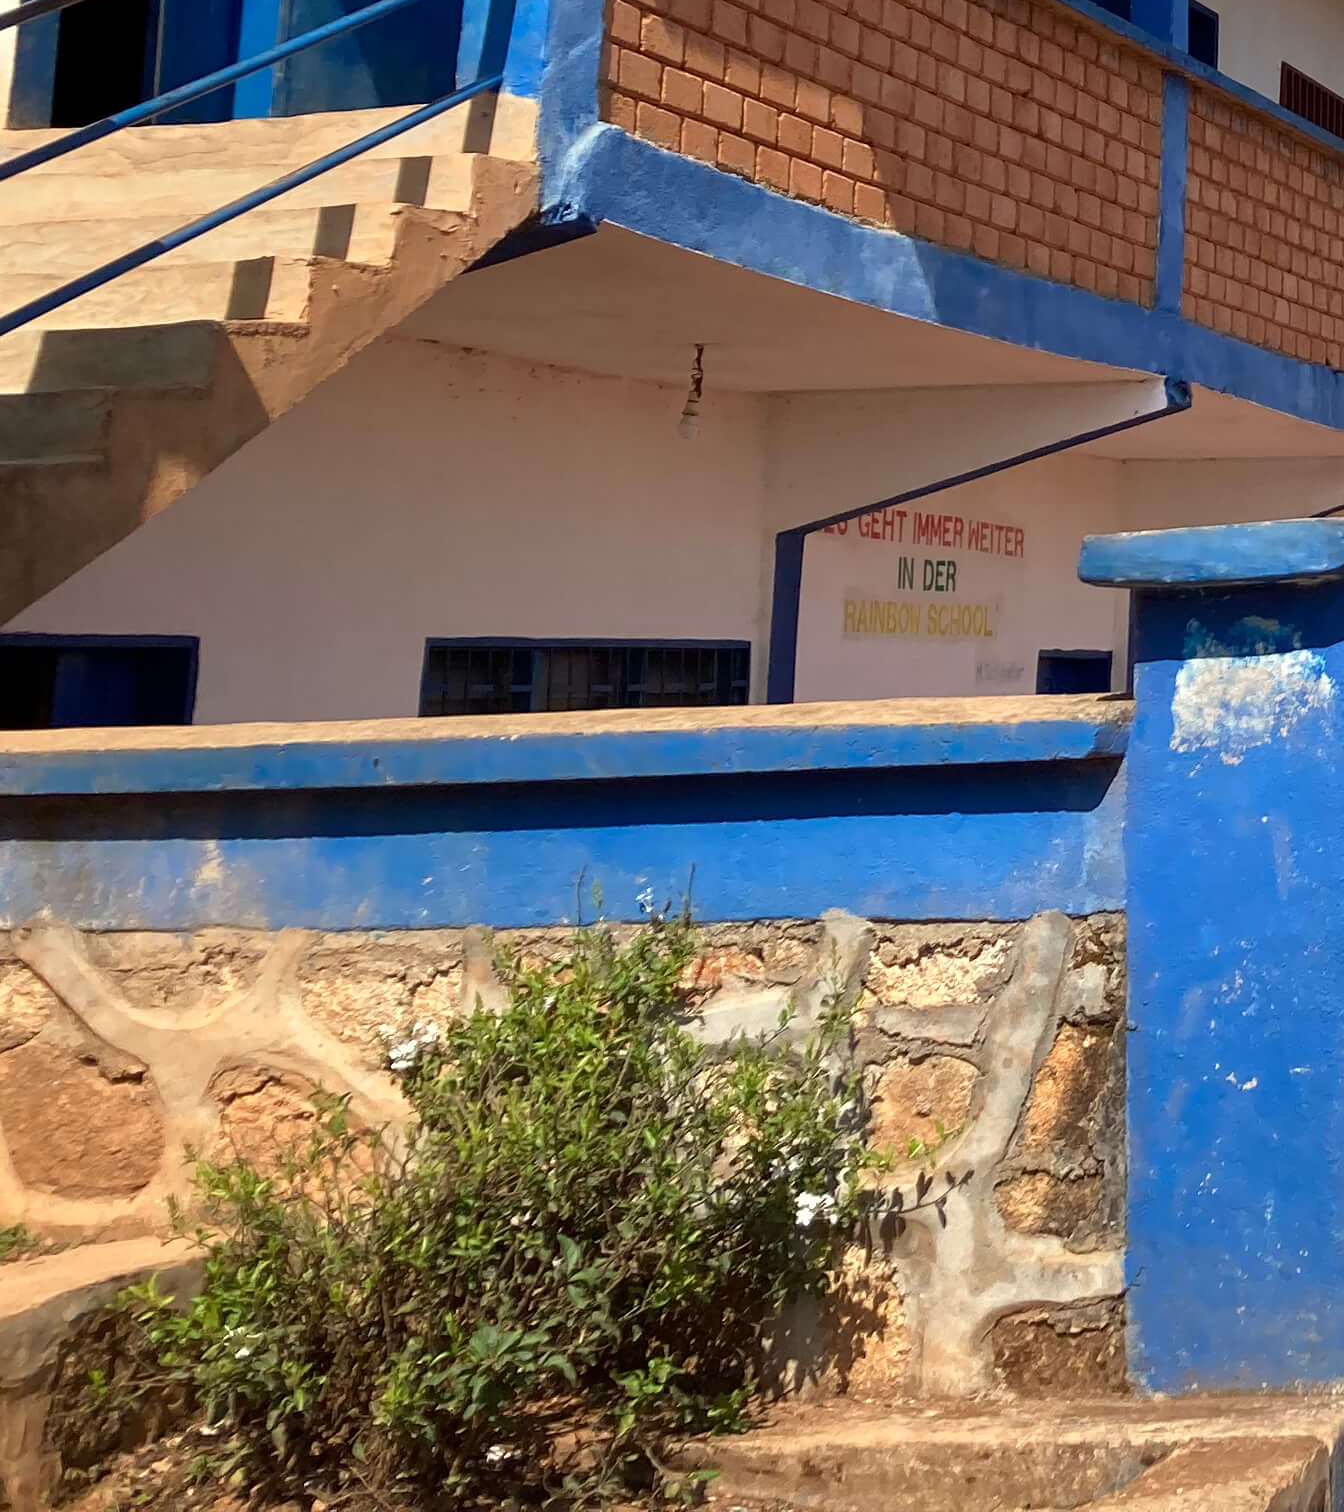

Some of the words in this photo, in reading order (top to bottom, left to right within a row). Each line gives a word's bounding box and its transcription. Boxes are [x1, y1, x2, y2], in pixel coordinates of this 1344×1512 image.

[858, 508, 907, 542] GEHT
[913, 512, 963, 548] IMMER
[968, 520, 1024, 558] WEITER
[898, 557, 914, 590] IN
[923, 560, 957, 592] DER
[843, 600, 920, 633] RAINBOW
